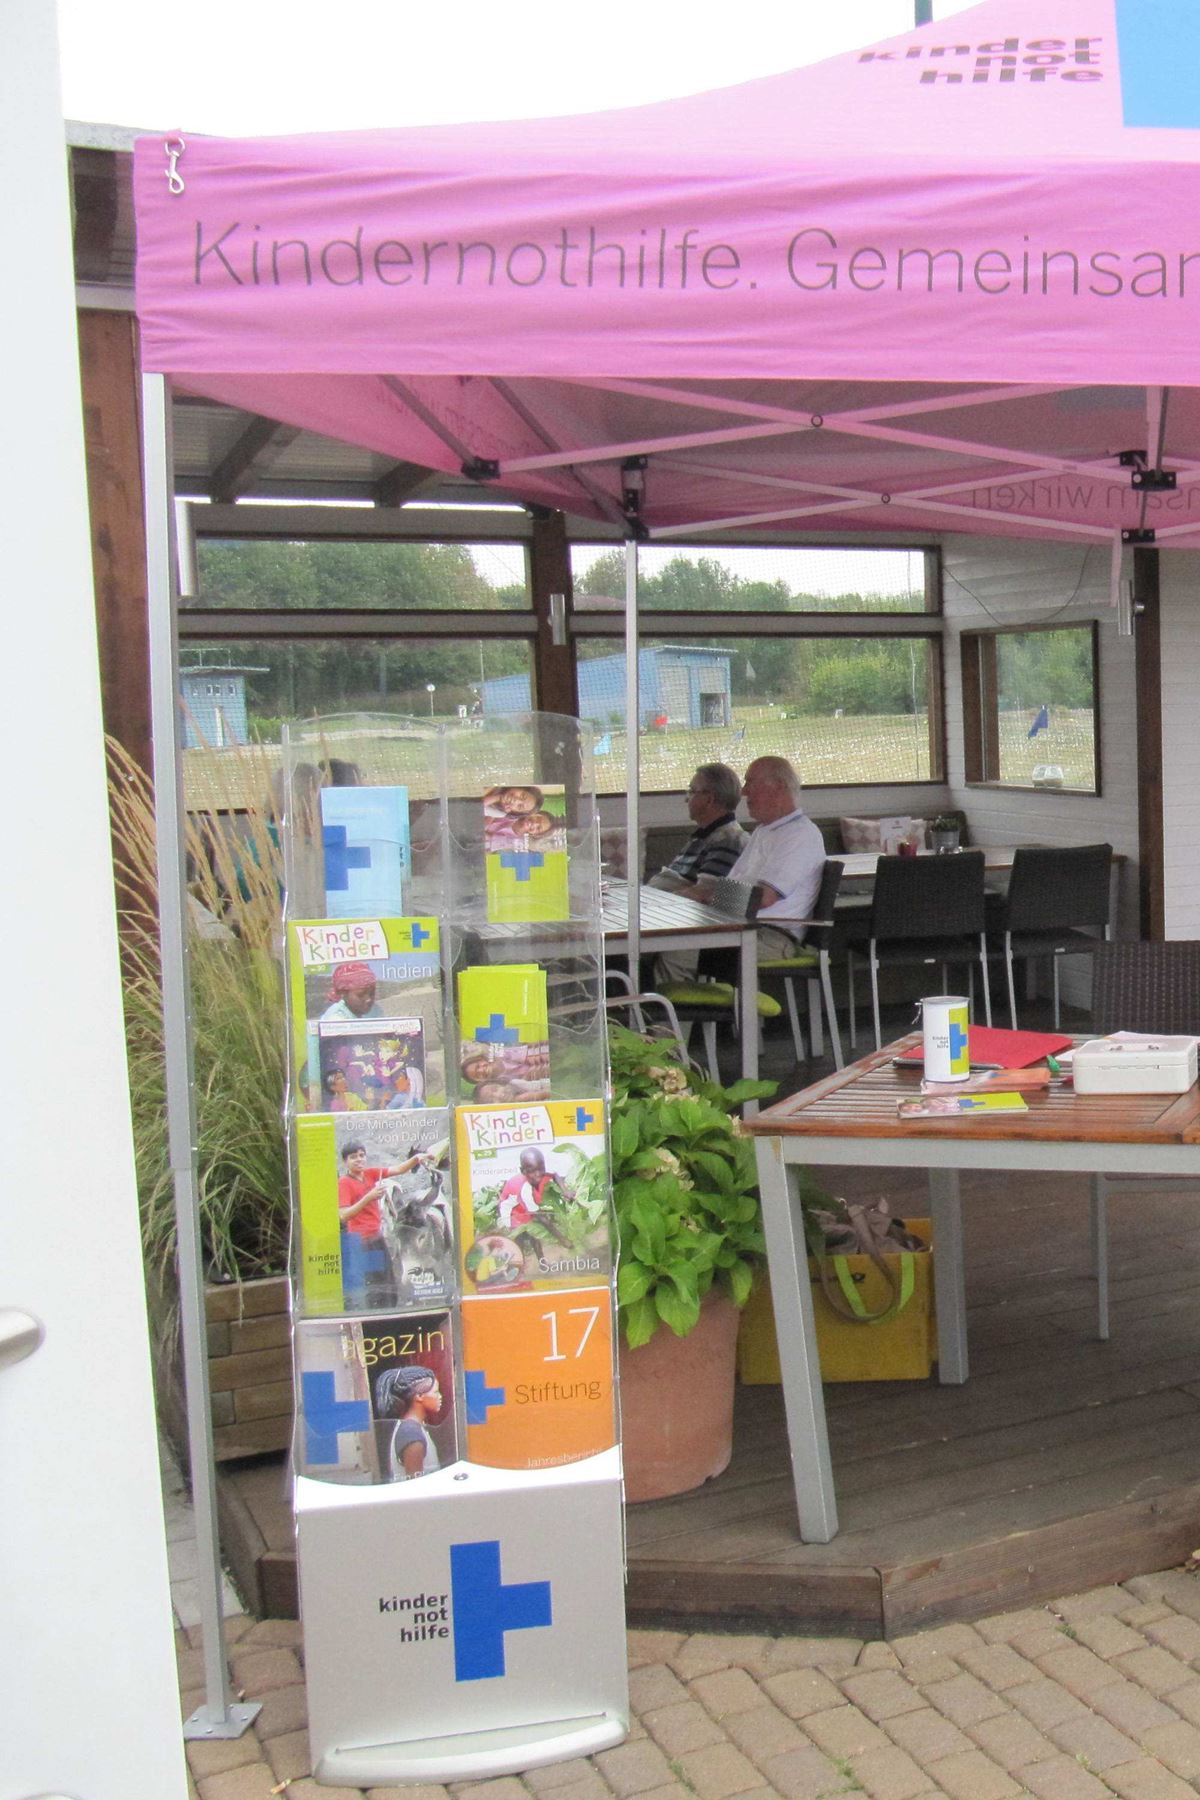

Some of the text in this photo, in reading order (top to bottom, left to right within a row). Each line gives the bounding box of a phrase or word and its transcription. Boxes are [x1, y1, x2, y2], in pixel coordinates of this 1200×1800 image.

[858, 38, 1103, 63] kinder
[975, 51, 1101, 67] not
[919, 67, 1104, 84] hilfe
[193, 220, 758, 291] Kindernothilfe.
[302, 925, 375, 945] Kinder
[310, 940, 380, 961] Kinder
[382, 963, 432, 979] Indien
[470, 1110, 541, 1131] Kinder
[476, 1126, 546, 1147] Kinder
[308, 1253, 340, 1263] kinder
[538, 1255, 601, 1274] Sambia
[318, 1267, 340, 1276] hilfe
[541, 1305, 600, 1364] 17
[341, 1326, 445, 1366] agazin
[515, 1378, 601, 1406] Stiftung
[379, 1592, 449, 1613] kinder
[413, 1608, 449, 1625] not
[400, 1624, 450, 1643] hilfe
